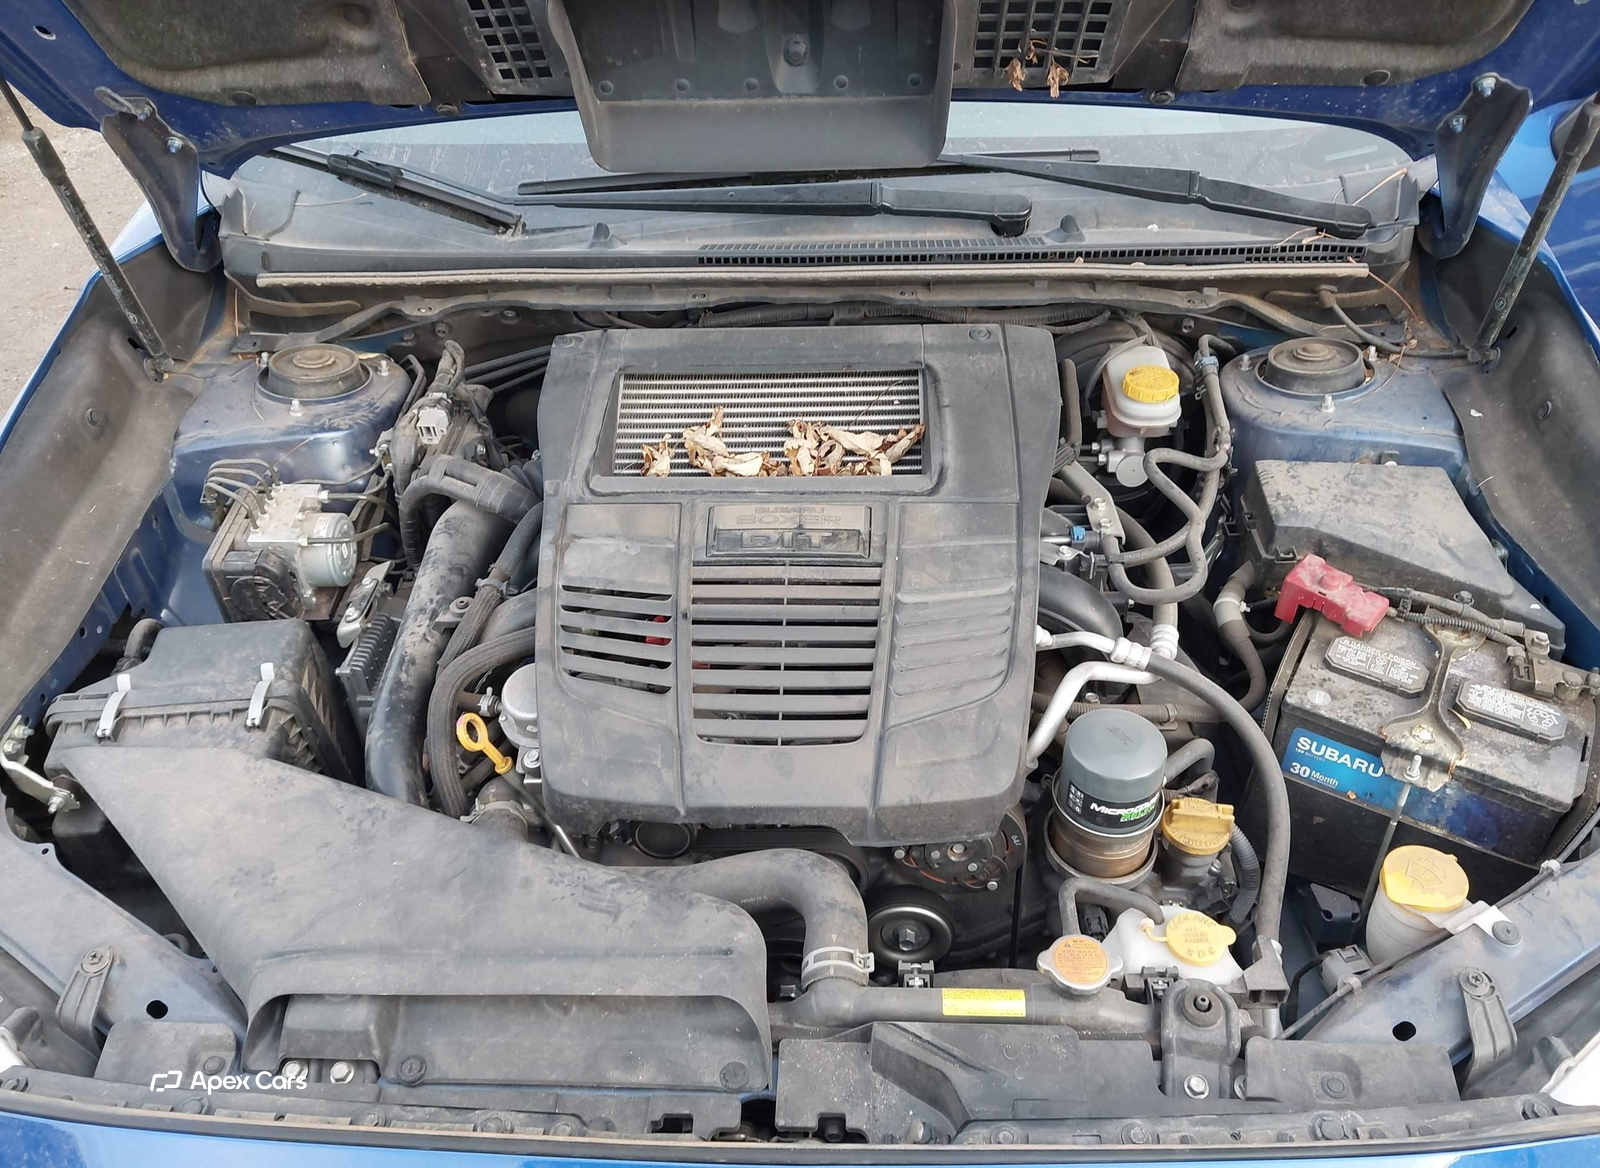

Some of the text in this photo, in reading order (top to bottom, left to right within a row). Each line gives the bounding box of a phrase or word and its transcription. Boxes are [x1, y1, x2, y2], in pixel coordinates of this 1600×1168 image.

[754, 506, 825, 514] SUBARU
[736, 514, 842, 525] BOXER
[1297, 736, 1384, 778] SUBARU
[1290, 762, 1311, 778] 30
[1311, 770, 1339, 787] Month
